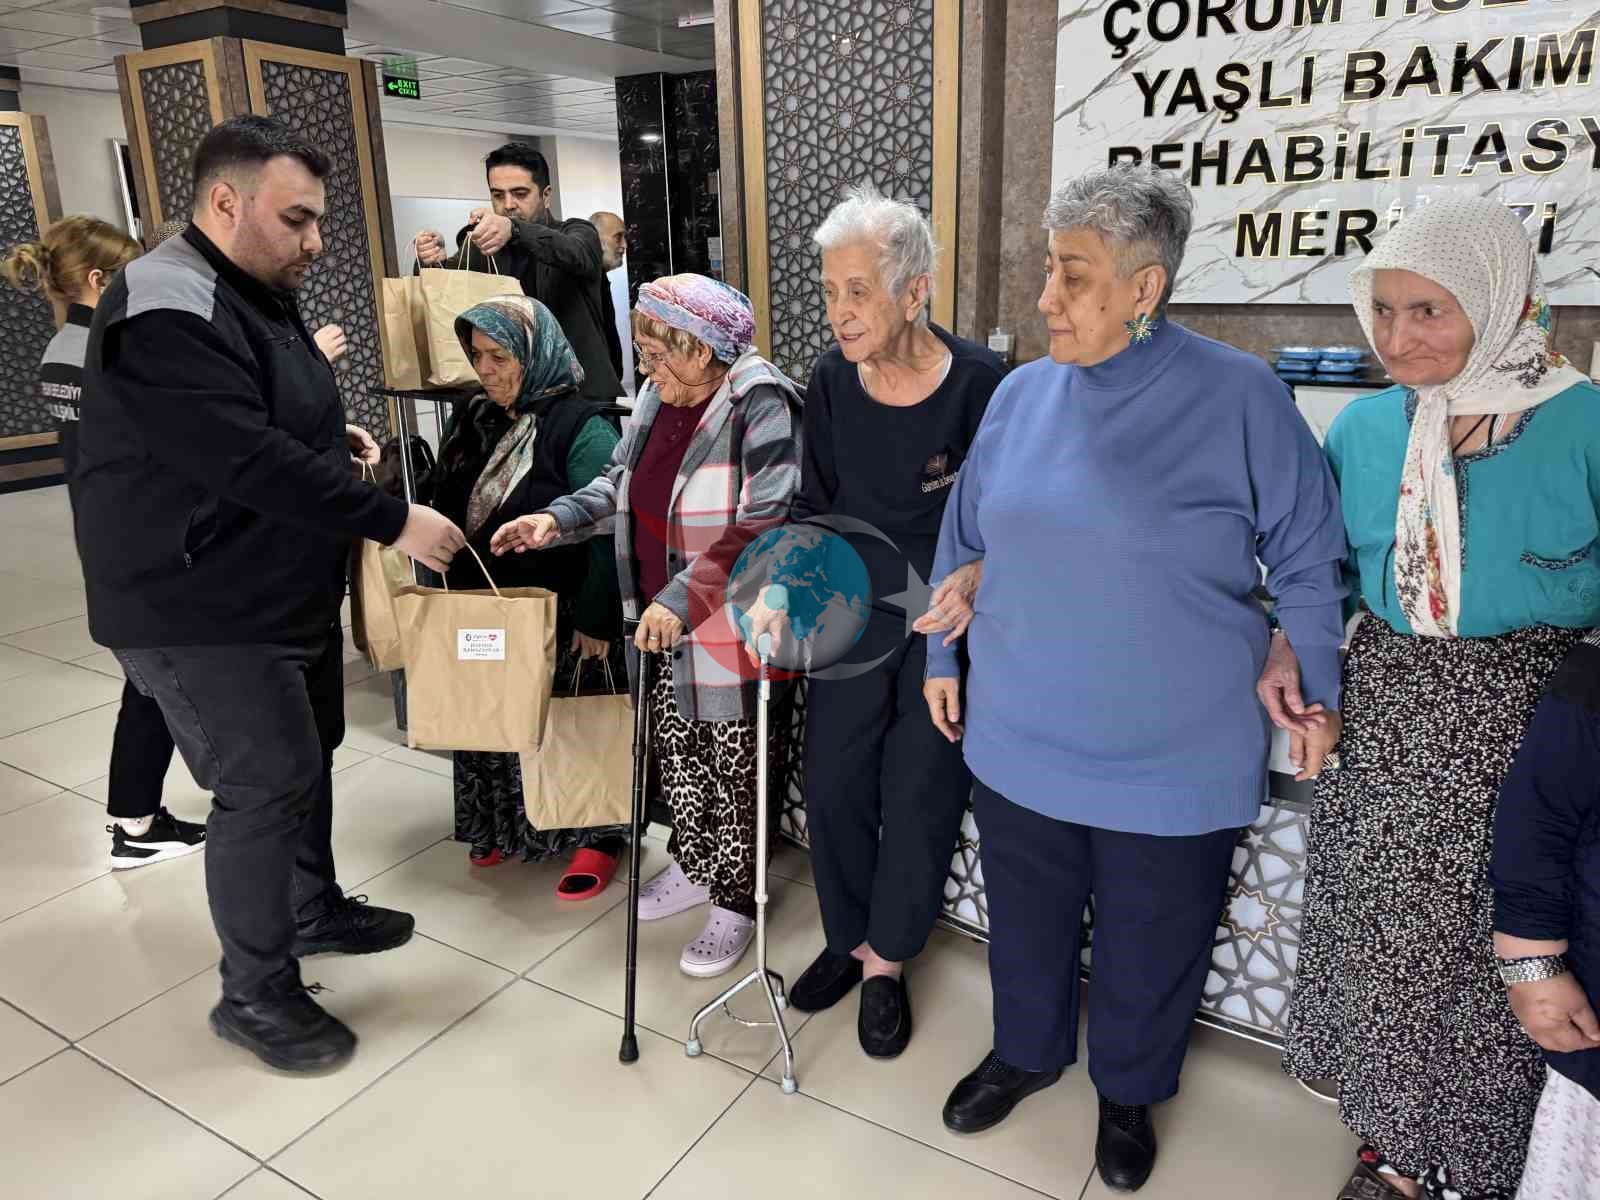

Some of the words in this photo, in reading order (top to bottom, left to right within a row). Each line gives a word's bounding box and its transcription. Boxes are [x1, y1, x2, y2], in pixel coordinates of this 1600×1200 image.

[397, 80, 416, 89] EXIT
[1132, 56, 1316, 122] YAŞLI
[1342, 29, 1594, 104] BAKIM
[1236, 203, 1557, 257] MERİ
